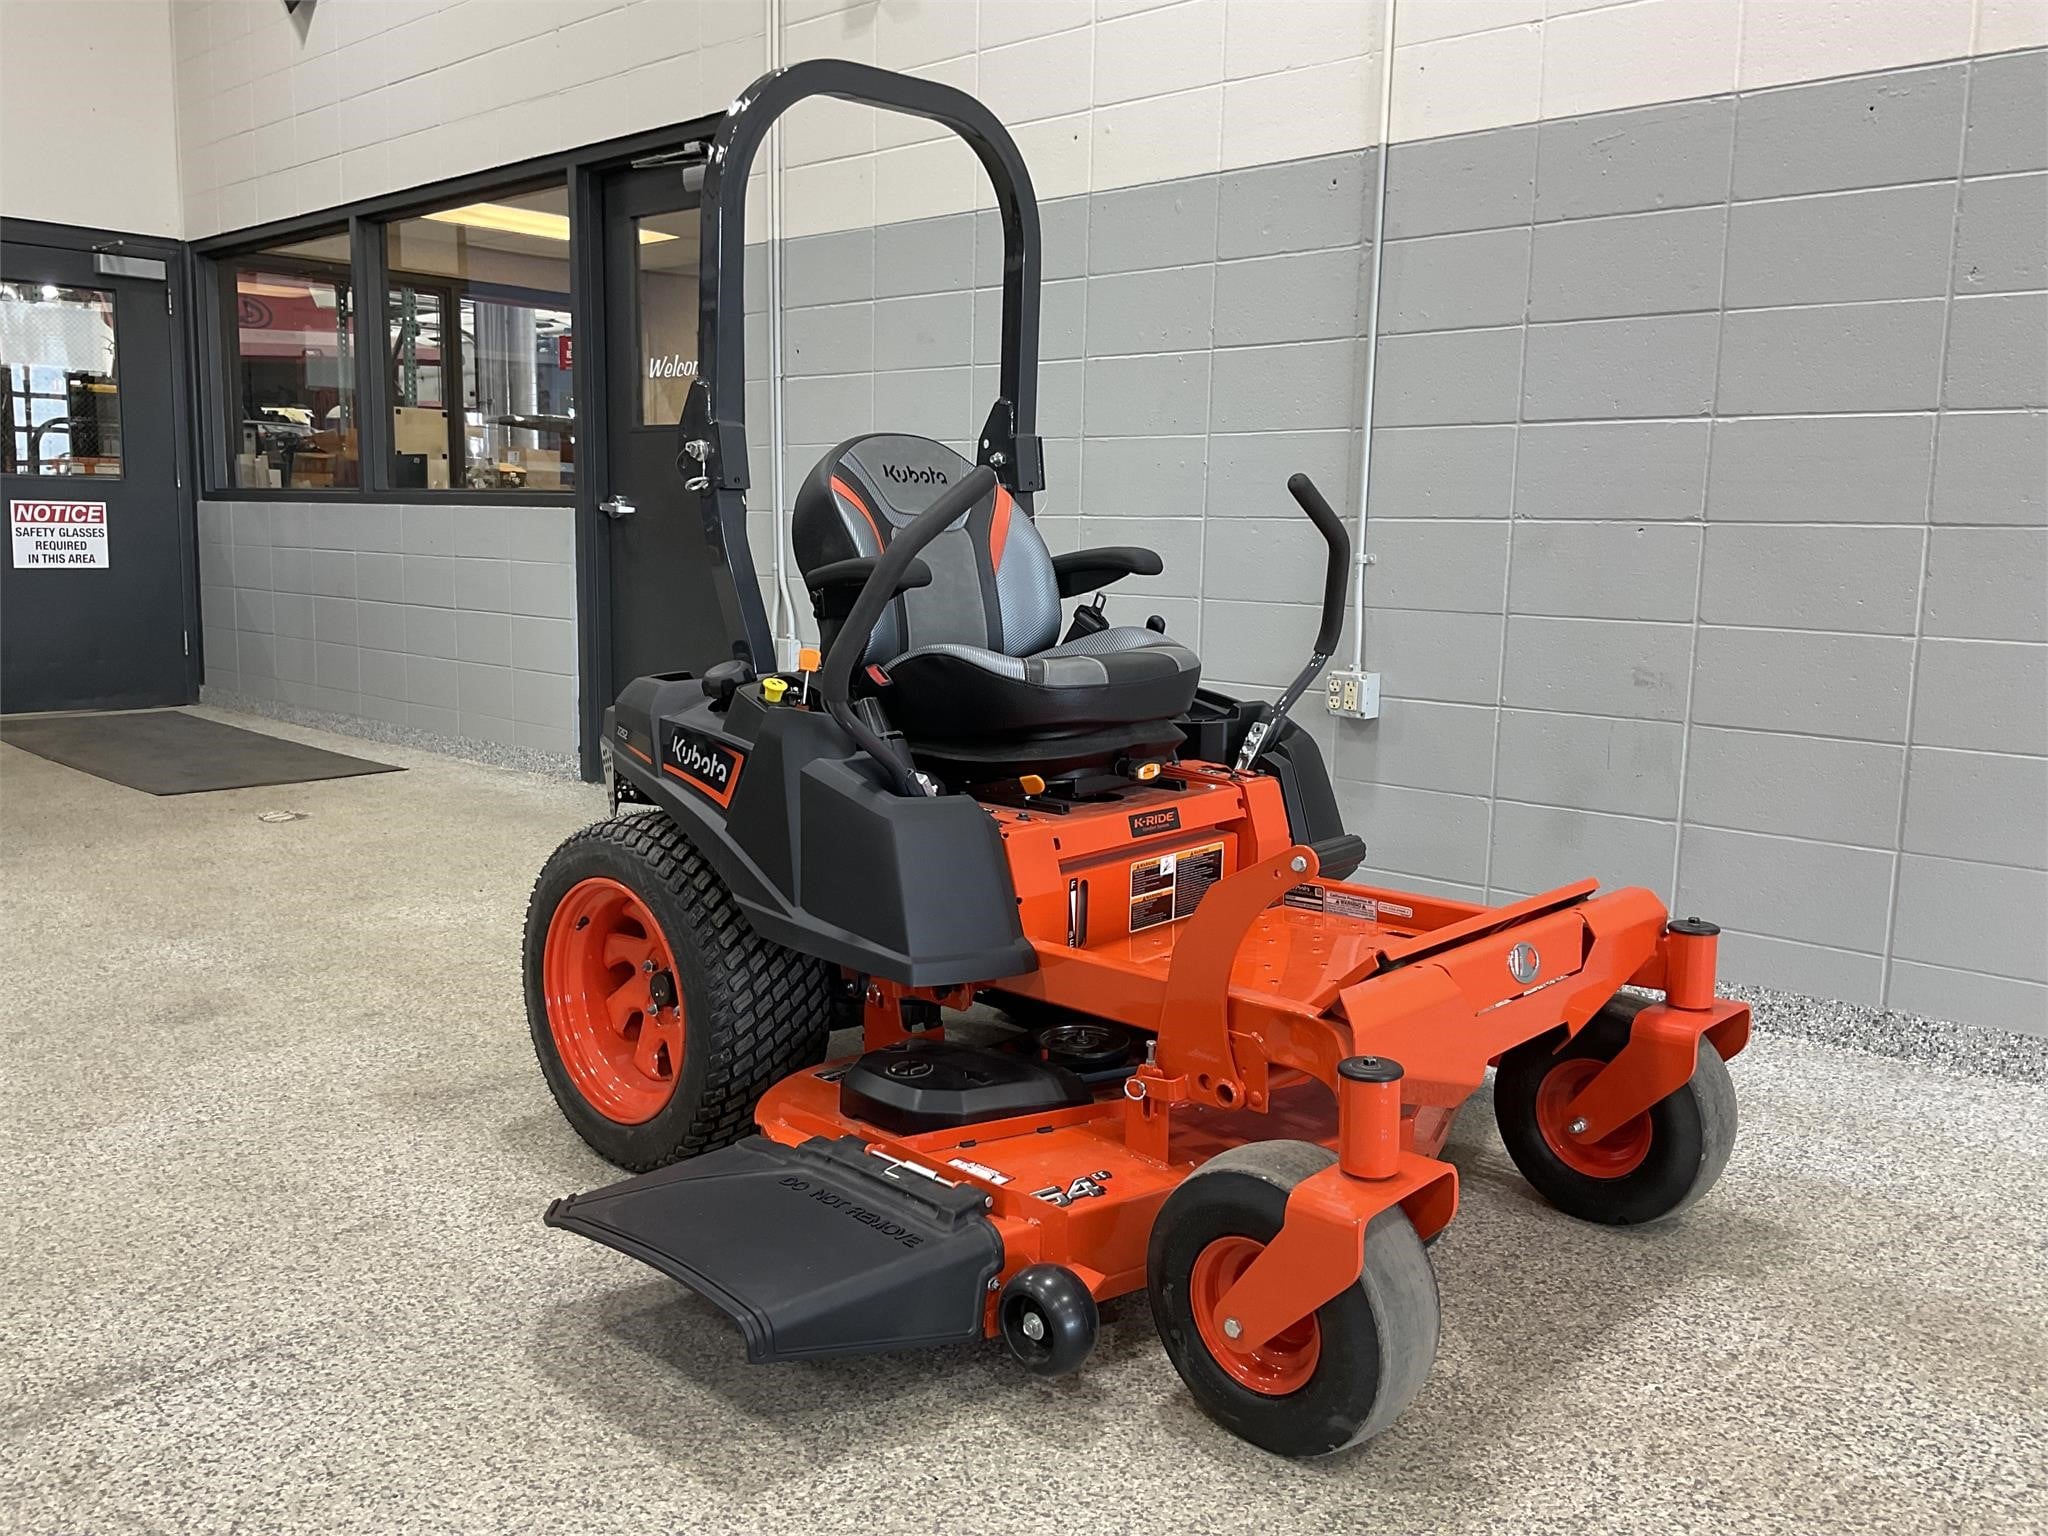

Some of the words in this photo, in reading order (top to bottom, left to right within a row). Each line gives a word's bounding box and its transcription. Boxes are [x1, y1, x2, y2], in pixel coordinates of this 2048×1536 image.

[649, 354, 699, 378] Welco
[882, 464, 948, 485] Kubota
[15, 504, 103, 523] NOTICE
[15, 527, 55, 537] SAFETY
[58, 528, 105, 538] GLASSES
[35, 541, 88, 551] REQUIRED
[28, 554, 39, 563] IN
[41, 554, 66, 563] THIS
[68, 554, 96, 563] AREA
[672, 735, 728, 783] Kubota
[1070, 880, 1076, 890] F
[779, 1176, 810, 1191] DO
[809, 1189, 852, 1209] NOT
[845, 1207, 924, 1248] REMOVE
